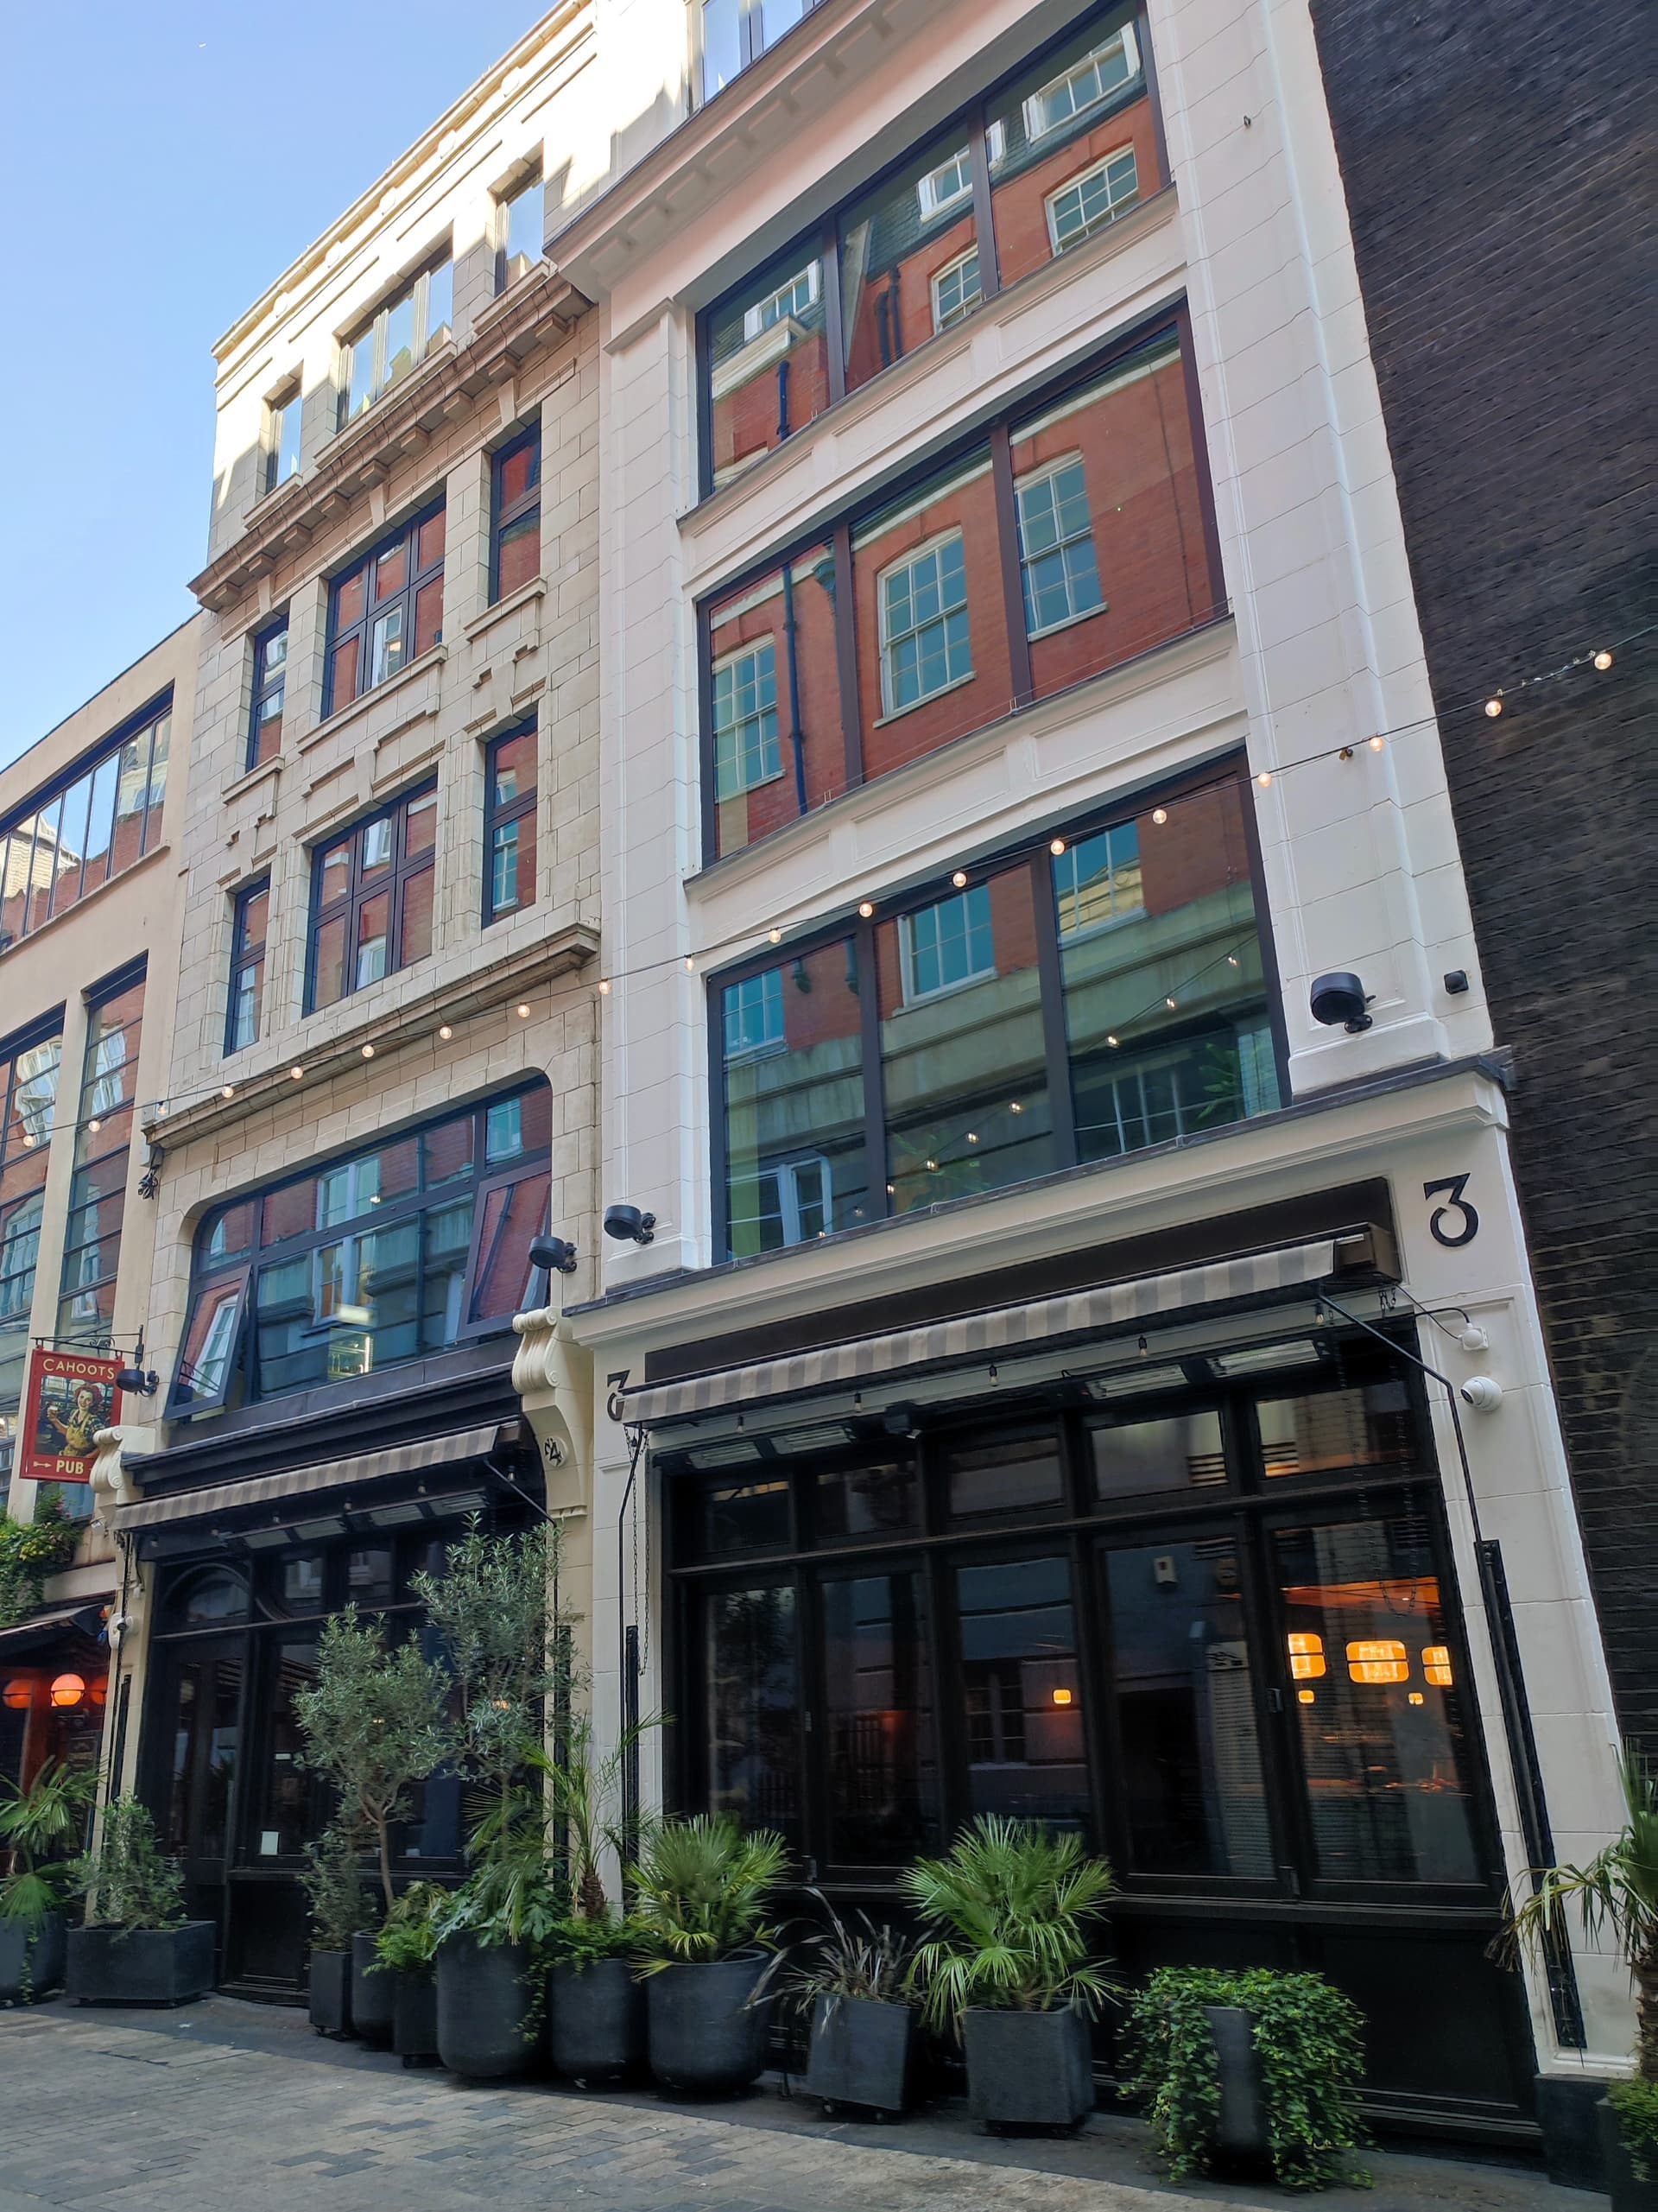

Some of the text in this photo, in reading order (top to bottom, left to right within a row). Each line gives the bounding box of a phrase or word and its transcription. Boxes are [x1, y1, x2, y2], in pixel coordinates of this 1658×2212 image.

[1423, 1172, 1478, 1247] 3
[42, 1358, 115, 1380] CAHOOTS
[56, 1459, 84, 1474] PUB
